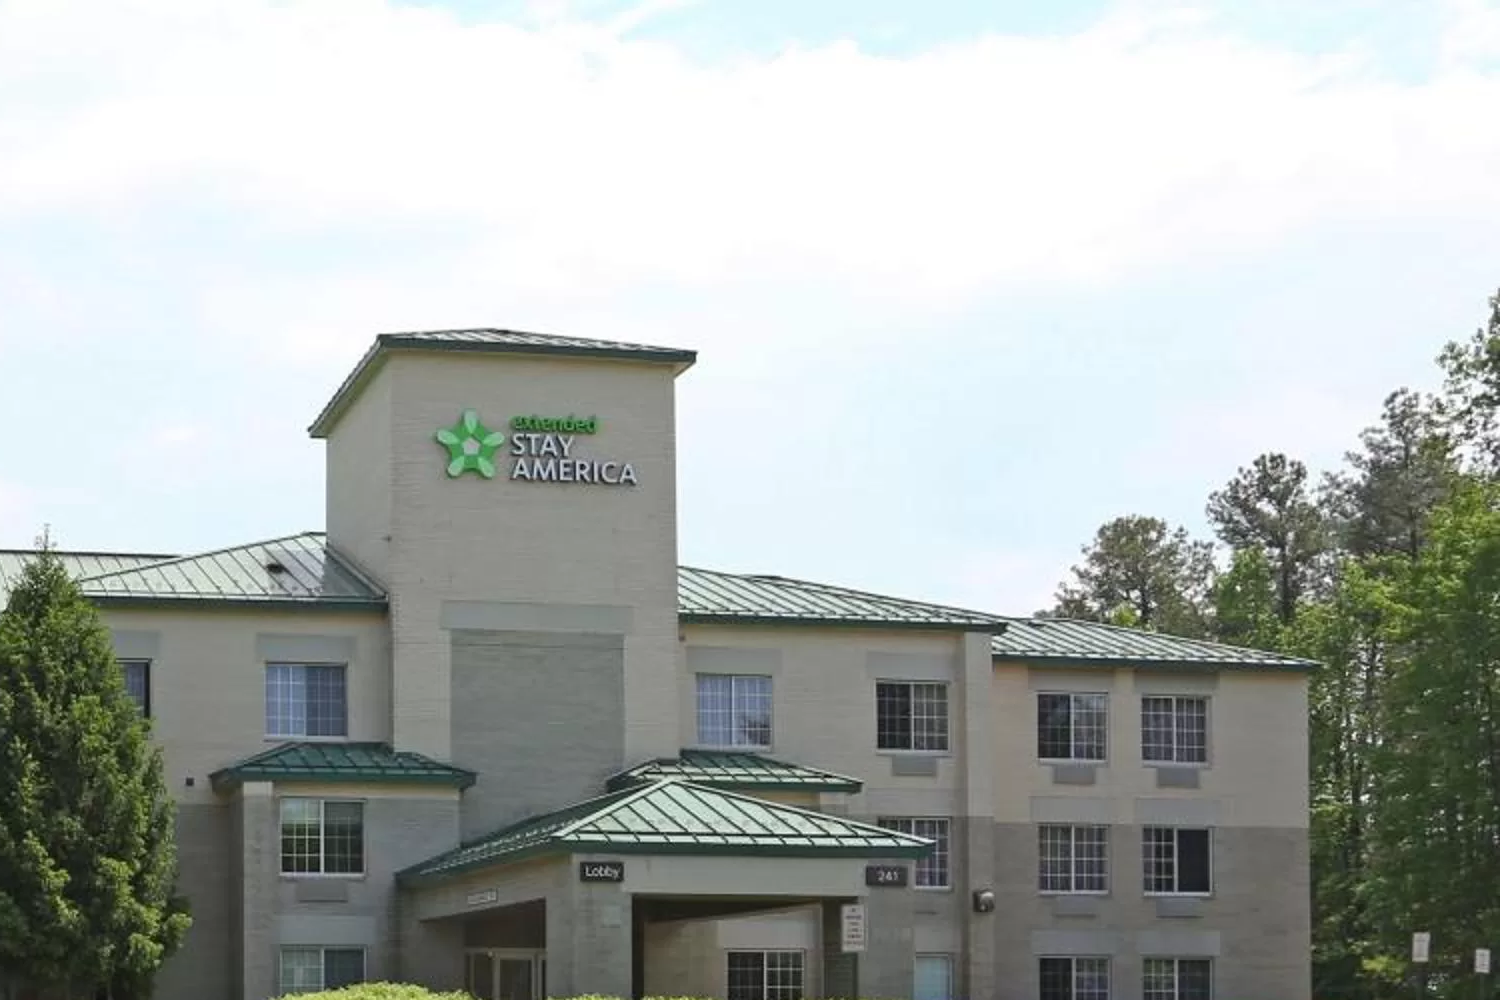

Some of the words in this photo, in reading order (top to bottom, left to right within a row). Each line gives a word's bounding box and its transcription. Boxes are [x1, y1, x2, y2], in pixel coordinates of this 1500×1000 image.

[511, 414, 597, 434] extended
[511, 433, 574, 457] STAY
[511, 459, 637, 484] AMERICA
[585, 865, 619, 880] Lobby
